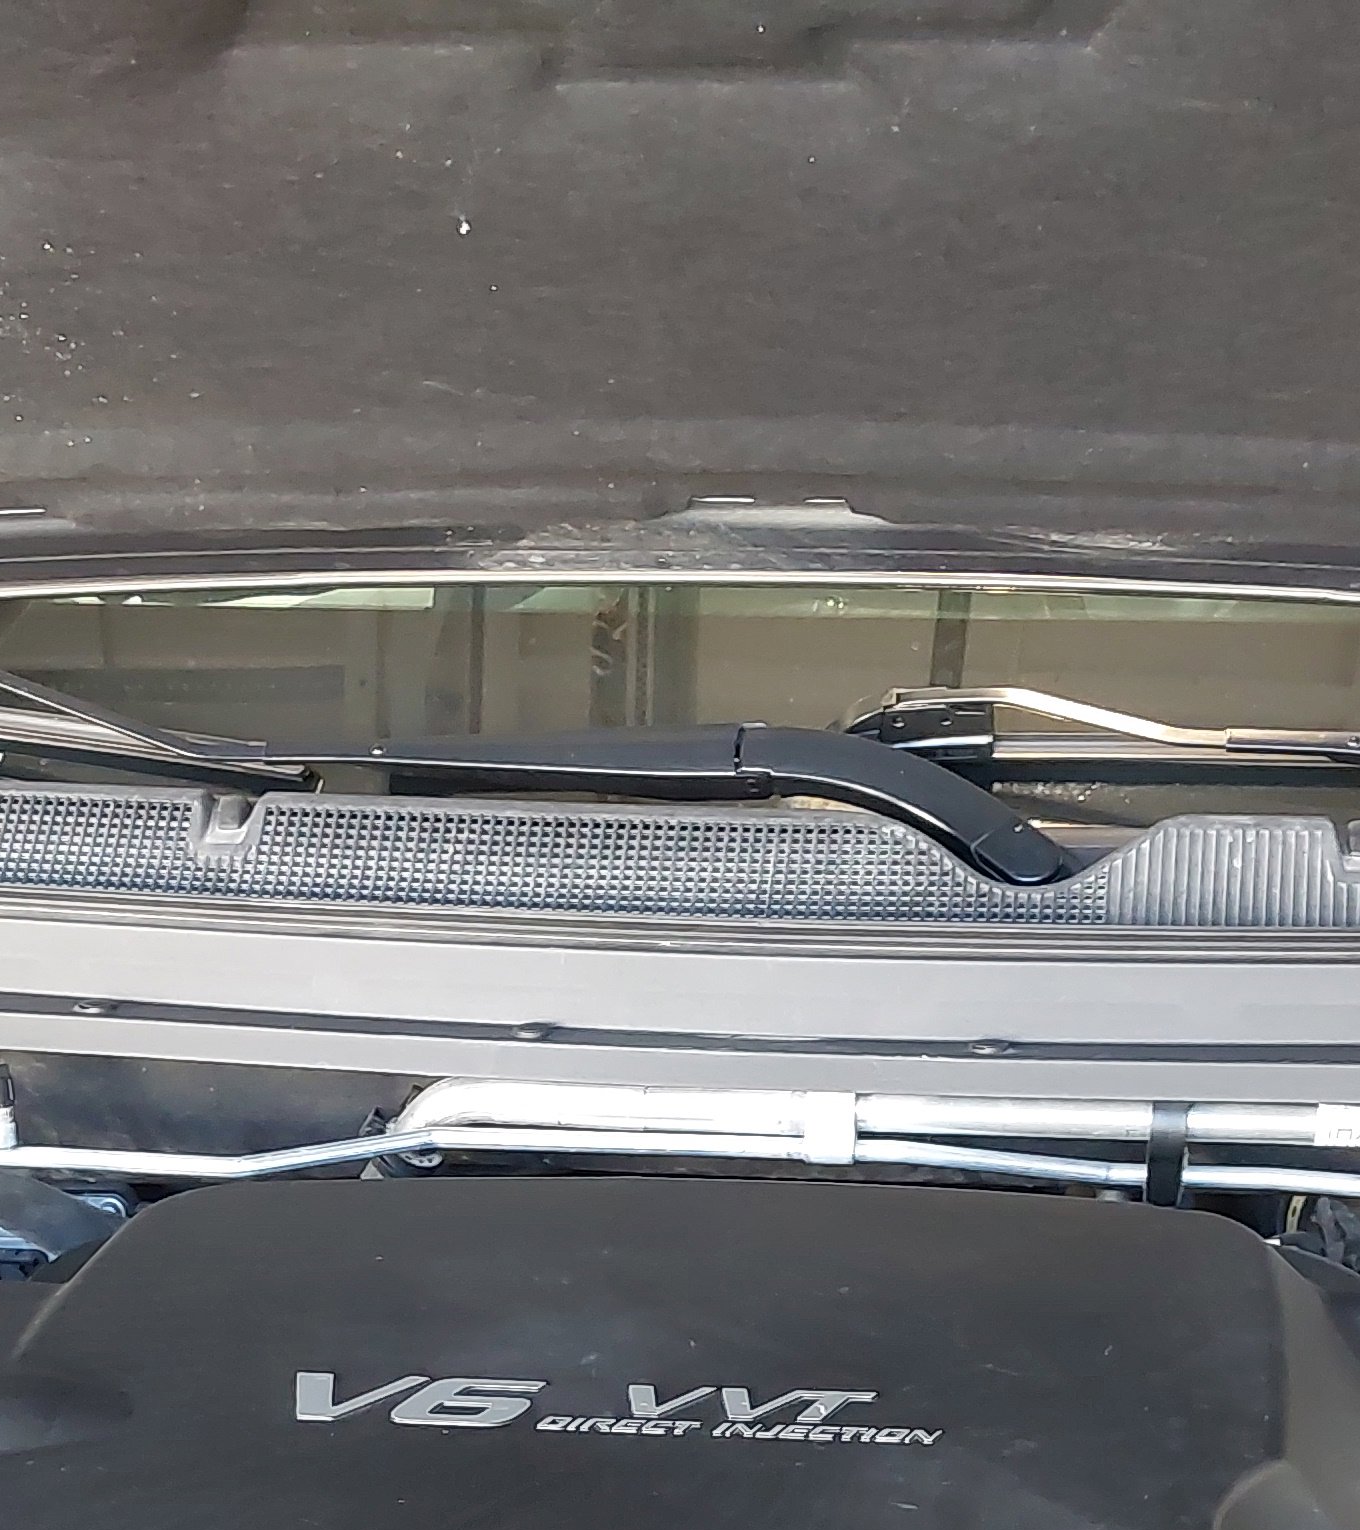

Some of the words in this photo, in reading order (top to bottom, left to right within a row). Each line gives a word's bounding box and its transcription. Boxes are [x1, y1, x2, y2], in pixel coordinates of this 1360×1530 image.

[294, 1371, 550, 1427] V6
[628, 1384, 880, 1424] VVT
[535, 1415, 702, 1437] DIRECT
[711, 1421, 944, 1446] INJECTION
